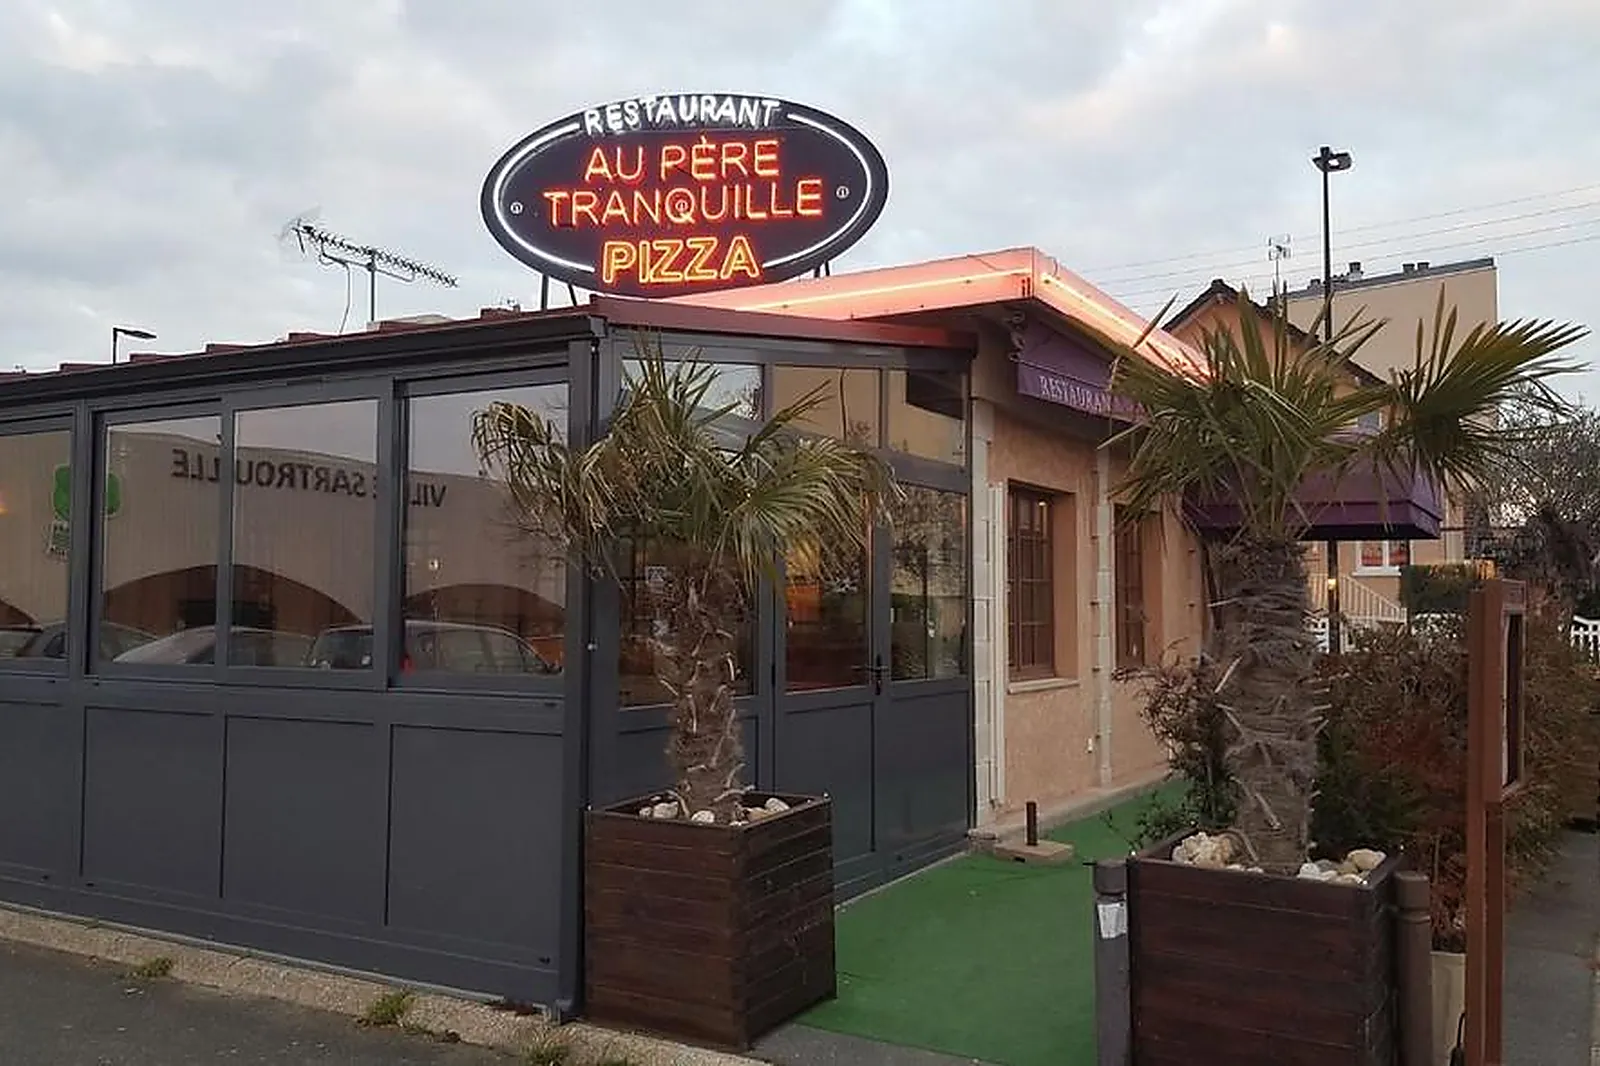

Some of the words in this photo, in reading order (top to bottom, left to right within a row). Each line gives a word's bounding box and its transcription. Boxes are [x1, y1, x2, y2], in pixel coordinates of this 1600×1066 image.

[584, 95, 780, 135] RESTAURANT
[585, 147, 642, 181] AU
[661, 136, 780, 179] PÈRE
[544, 179, 823, 226] TRANQUILLE
[603, 236, 760, 283] PIZZA
[1038, 374, 1115, 414] RESTAURAN
